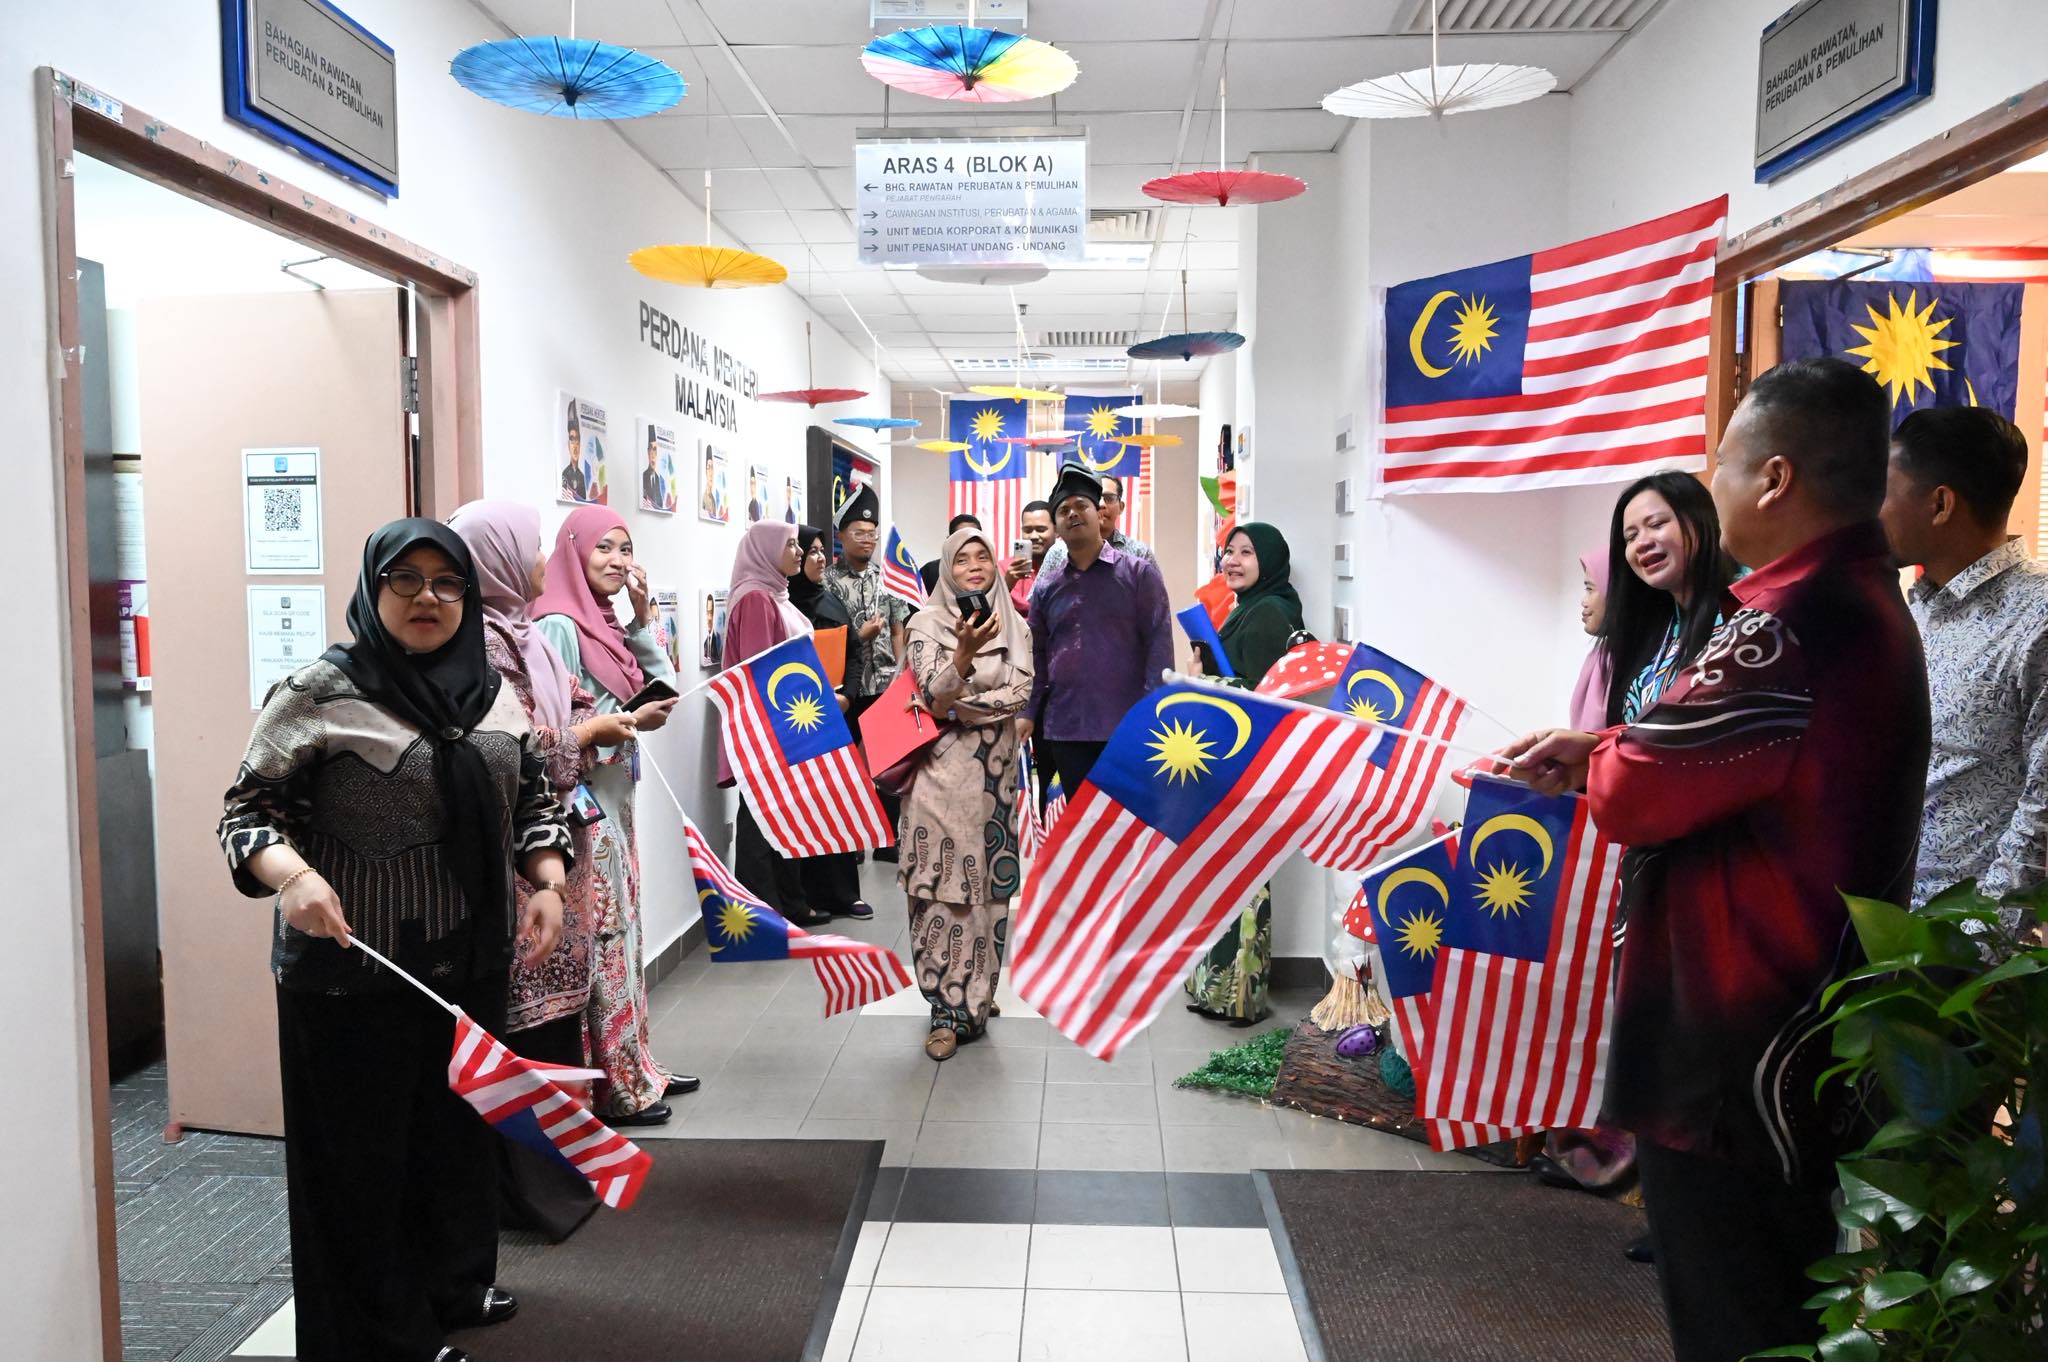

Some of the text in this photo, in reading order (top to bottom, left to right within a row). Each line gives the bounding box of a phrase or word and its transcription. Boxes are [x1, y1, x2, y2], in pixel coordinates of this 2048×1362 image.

[265, 21, 364, 98] BAHAGIAN RAWATAN,
[266, 42, 384, 129] PERUBATAN & PEMULIHAN
[1765, 22, 1884, 113] PERUBATAN & PEMULIHAN
[1766, 21, 1859, 95] BAHAGIAN RAWATAN,
[883, 155, 1053, 178] ARAS 4 (BLOK A)
[909, 182, 953, 191] RAWATAN
[958, 181, 1013, 191] PERUBATAN
[1015, 181, 1022, 190] &
[1024, 180, 1078, 190] PEMULIHAN
[885, 209, 936, 218] CAWANGAN
[985, 207, 1036, 217] PERUBATAN
[1038, 207, 1044, 216] &
[1046, 207, 1078, 216] AGAMA
[886, 225, 1078, 236] UNIT MEDIA KORPORAT & KOMUNIKASI
[887, 243, 910, 252] UNIT
[912, 242, 968, 252] PENASIHAT
[970, 241, 1014, 252] UNDANG
[1022, 241, 1066, 251] UNDANG
[639, 299, 709, 377] PERDANA
[675, 372, 738, 434] MALAYSIA
